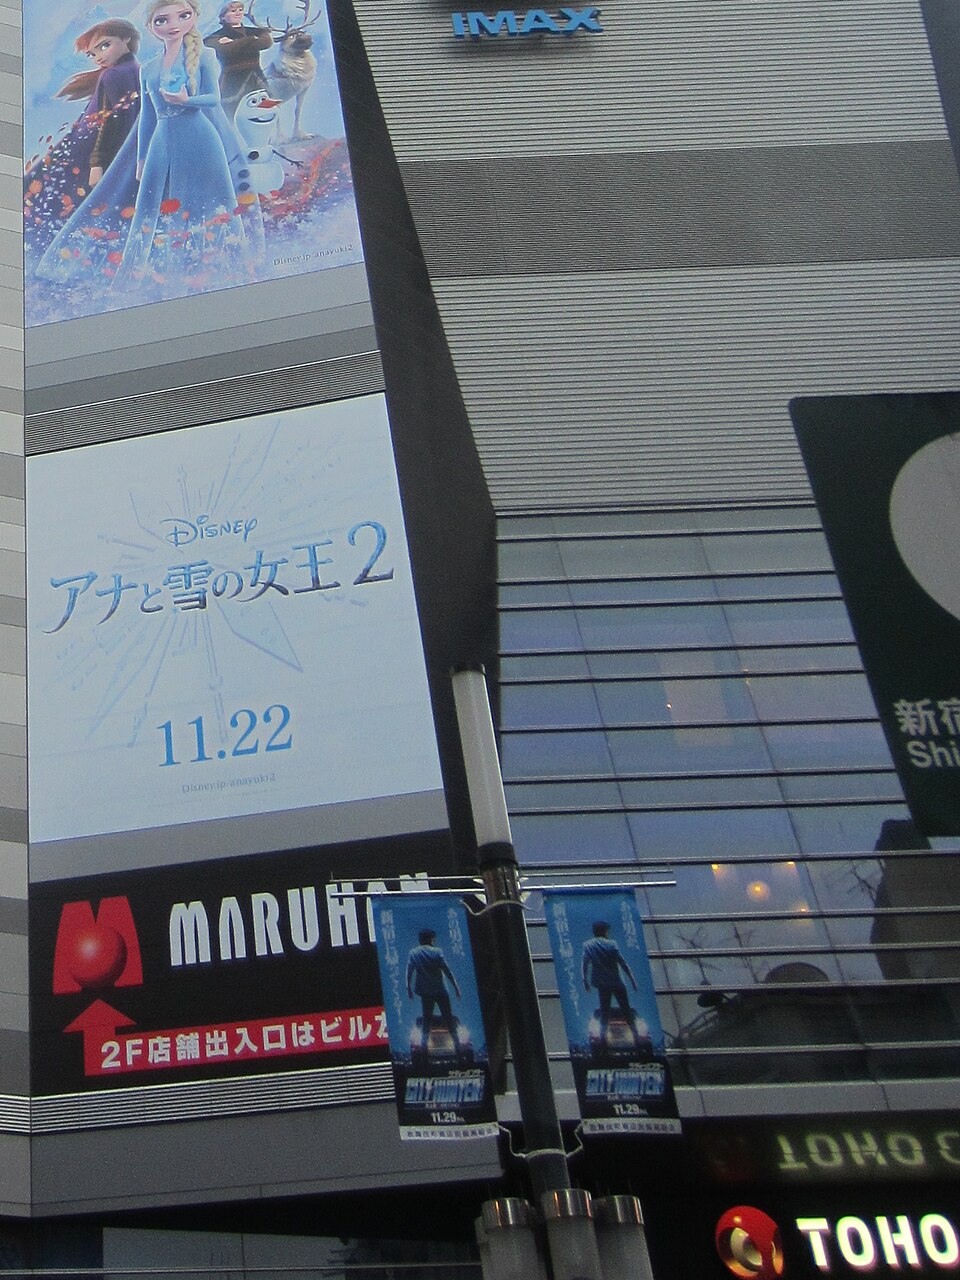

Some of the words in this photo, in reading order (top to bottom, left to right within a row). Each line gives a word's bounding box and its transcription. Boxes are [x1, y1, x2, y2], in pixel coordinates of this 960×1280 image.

[451, 7, 603, 38] IMAX
[156, 704, 294, 767] 11.22
[169, 872, 430, 967] MARUH
[431, 1111, 456, 1123] 11.29
[613, 1104, 640, 1115] 11.29
[796, 1213, 959, 1268] TOHO
